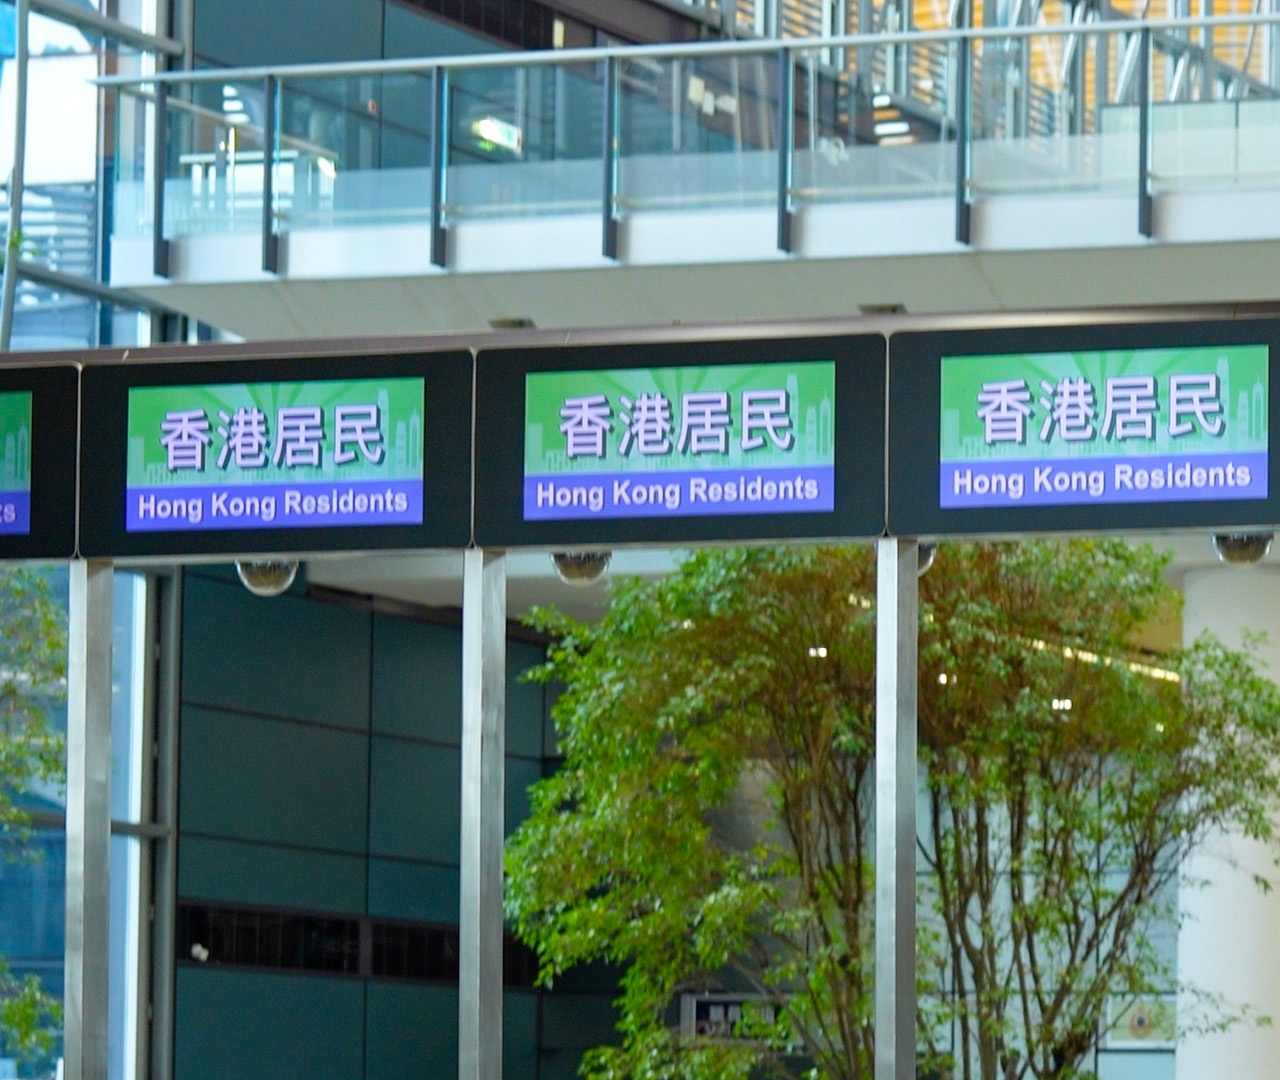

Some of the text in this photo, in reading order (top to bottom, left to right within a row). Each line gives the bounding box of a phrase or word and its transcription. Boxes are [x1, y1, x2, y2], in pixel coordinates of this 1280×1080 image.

[559, 388, 796, 458] 香港居民
[977, 373, 1223, 444] 香港居民
[160, 404, 385, 471] 香港居民
[536, 474, 819, 512] Hong Kong Residents
[953, 461, 1251, 499] Hong Kong Residents
[139, 489, 410, 525] Hong Kong Residents
